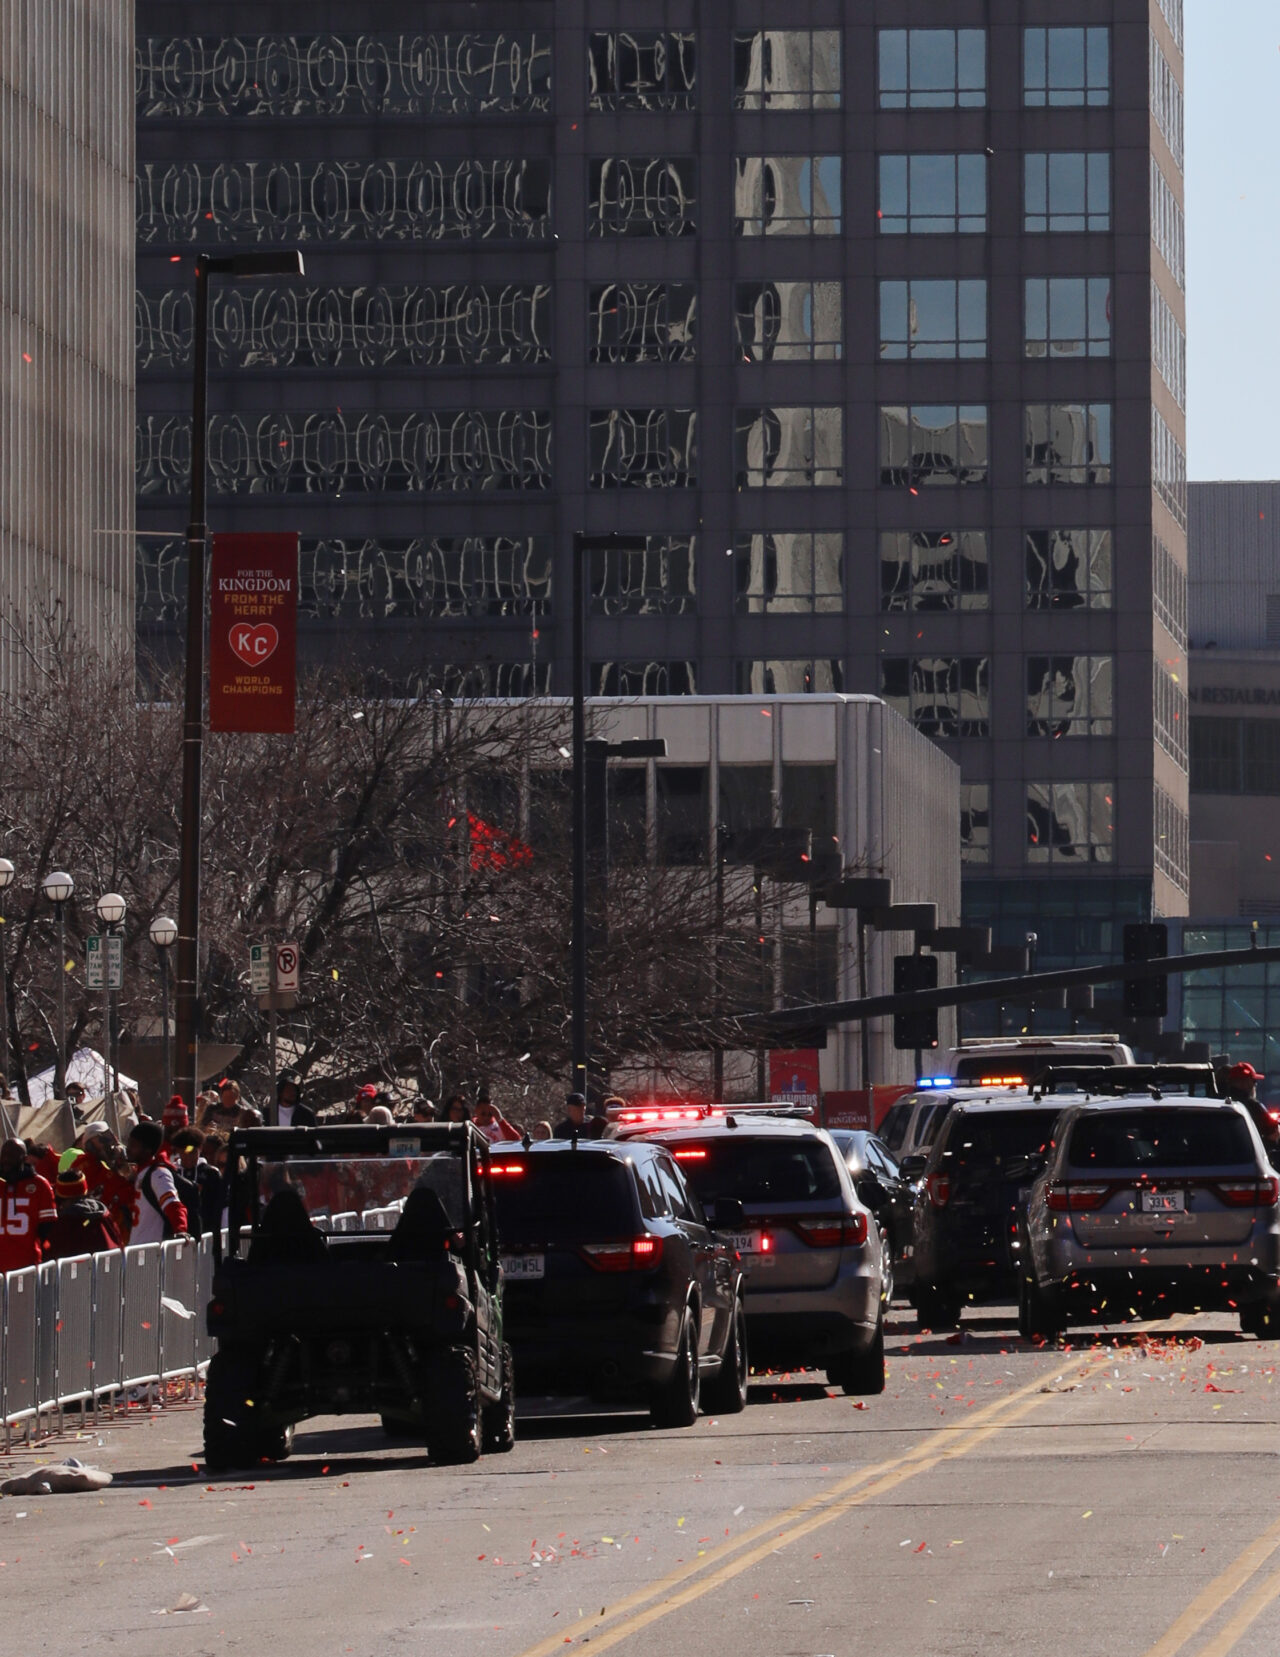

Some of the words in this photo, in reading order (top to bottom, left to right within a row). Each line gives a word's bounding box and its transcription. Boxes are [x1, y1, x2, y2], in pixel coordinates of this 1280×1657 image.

[218, 578, 291, 592] KINGDOM
[224, 594, 259, 605] FROM
[263, 594, 285, 605] THE
[234, 605, 274, 616] HEART
[238, 633, 268, 655] KC
[235, 676, 271, 685] WORLD
[222, 685, 284, 694] CHAMPIONS
[91, 939, 98, 950] 3
